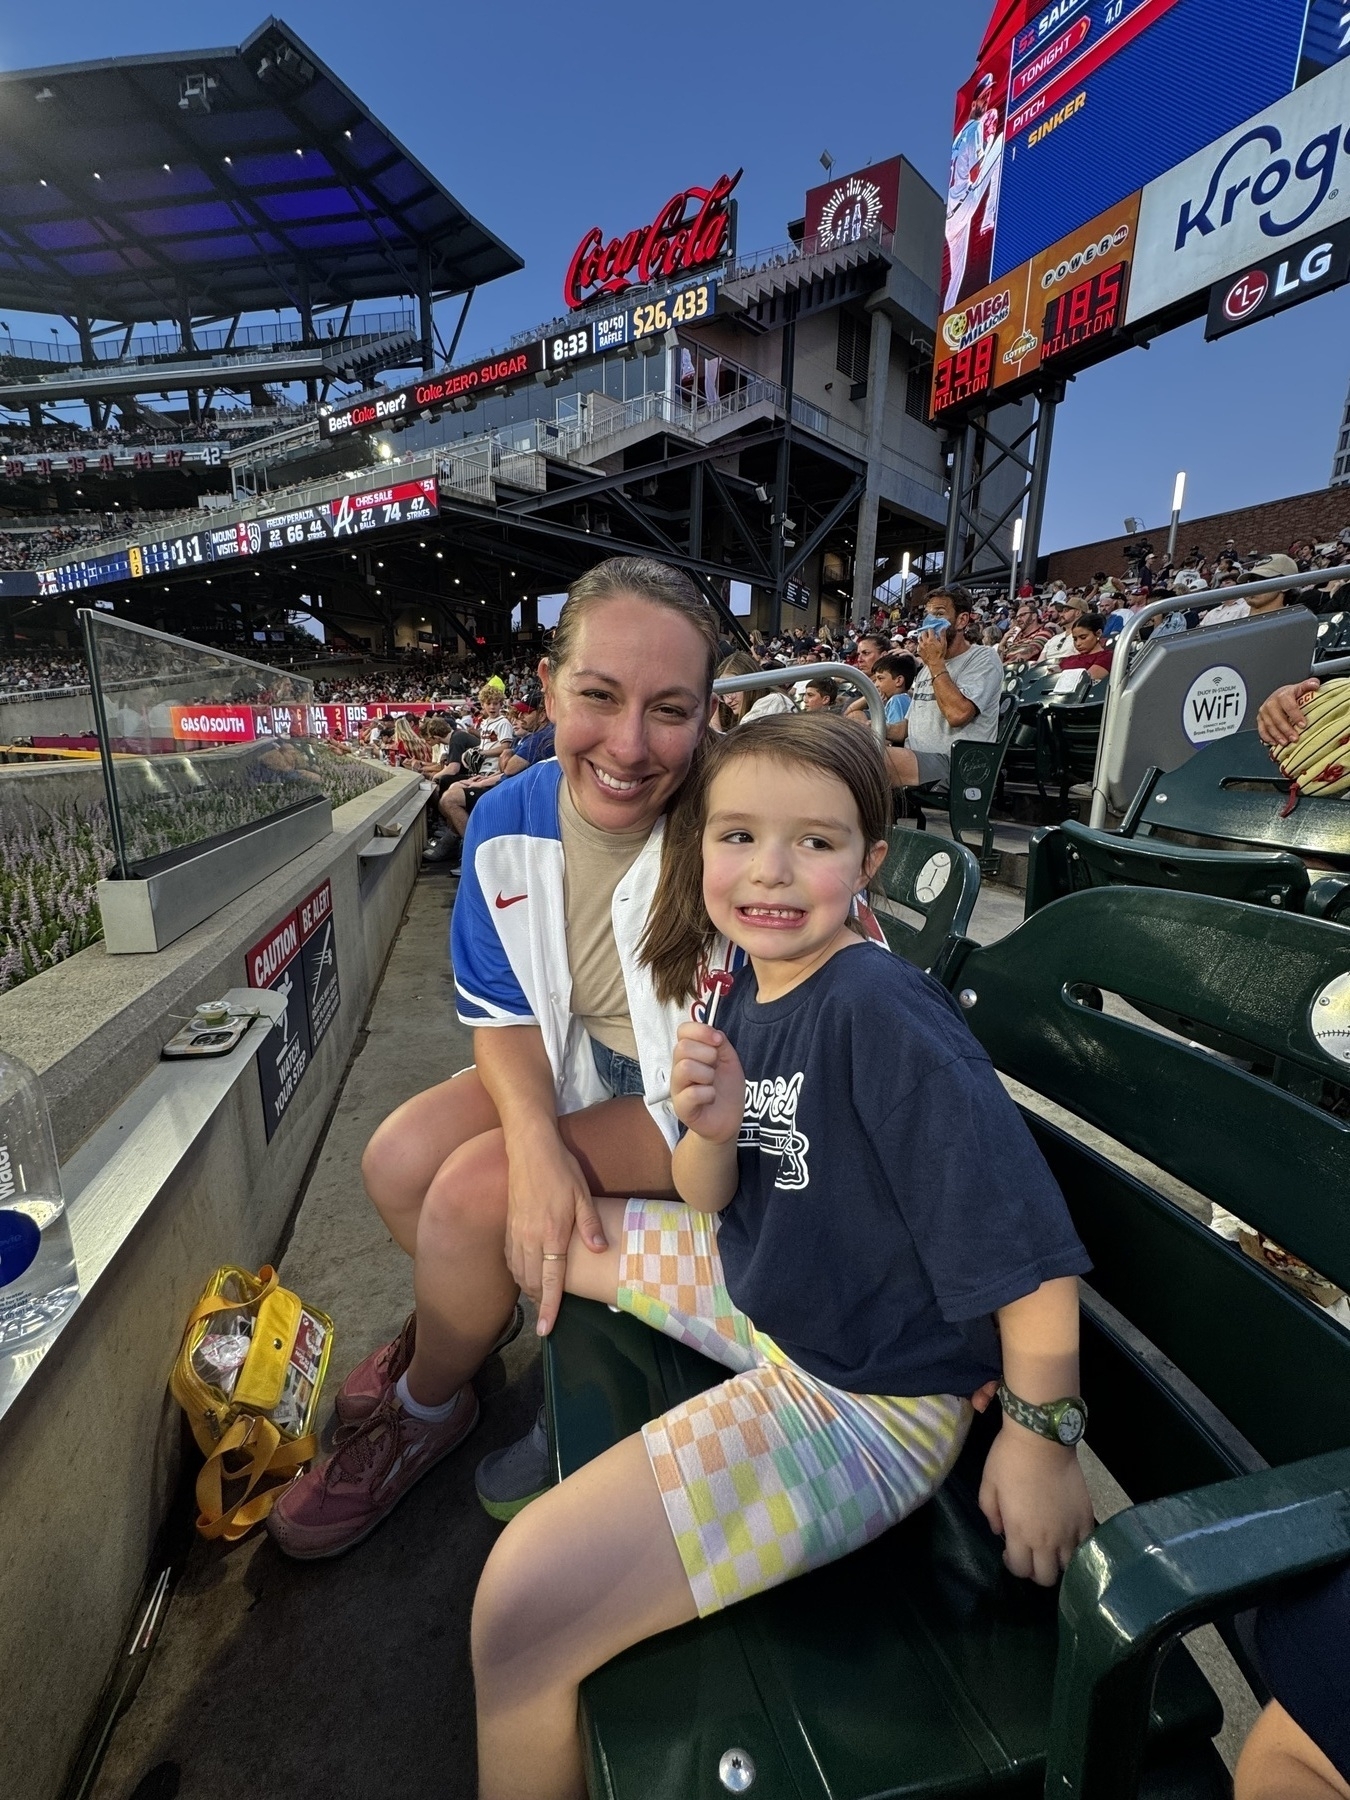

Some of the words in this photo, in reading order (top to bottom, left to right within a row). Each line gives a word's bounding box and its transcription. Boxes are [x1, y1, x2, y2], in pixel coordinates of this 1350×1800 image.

[1021, 34, 1072, 87] TONIGHT
[1013, 95, 1046, 131] PITCH
[1028, 91, 1087, 149] SINKER
[1275, 243, 1334, 297] LG
[965, 289, 1011, 331] MEGA
[1054, 263, 1121, 334] 185
[598, 314, 625, 336] 50/50
[632, 285, 709, 340] $26,433
[599, 329, 623, 348] RAFFLE
[958, 308, 1010, 351] MILLIONS
[1041, 309, 1115, 360] MILLION
[553, 331, 588, 361] 8:33
[1003, 338, 1037, 362] LOTTERY
[416, 380, 444, 405] Coke
[444, 370, 478, 397] ZERO
[480, 354, 528, 383] SUGAR
[934, 373, 989, 411] MILLION
[328, 413, 353, 434] Best
[352, 403, 376, 426] Coke
[376, 393, 407, 419] Ever?
[99, 454, 114, 471] 41
[134, 451, 152, 469] 44
[166, 449, 182, 466] 47
[200, 447, 221, 465] 42
[361, 508, 373, 522] 27
[382, 502, 401, 523] 74
[410, 496, 424, 511] 47
[374, 490, 393, 504] SALE
[266, 514, 290, 528] FREDDY
[290, 509, 314, 523] PERALTA
[270, 529, 280, 541] 22
[286, 524, 304, 543] 66
[310, 519, 322, 533] 44
[360, 520, 376, 530] BALLS
[406, 508, 430, 520] STRIKES
[212, 528, 237, 544] MOUND
[239, 523, 246, 536] 3
[269, 539, 283, 549] BALLS
[307, 530, 327, 541] STRIKES
[216, 542, 239, 556] VISITS
[240, 540, 248, 553] 4
[273, 707, 291, 721] LAA
[335, 708, 341, 720] 2
[347, 706, 367, 721] BOS
[1192, 692, 1240, 723] WiFi
[181, 717, 200, 733] GAS
[210, 717, 245, 733] SOUTH
[302, 906, 312, 934] BE
[312, 884, 331, 926] ALERT
[254, 919, 298, 988] CAUTION
[278, 1037, 300, 1085] WATCH
[274, 1078, 293, 1117] YOUR
[292, 1049, 307, 1092] STEP
